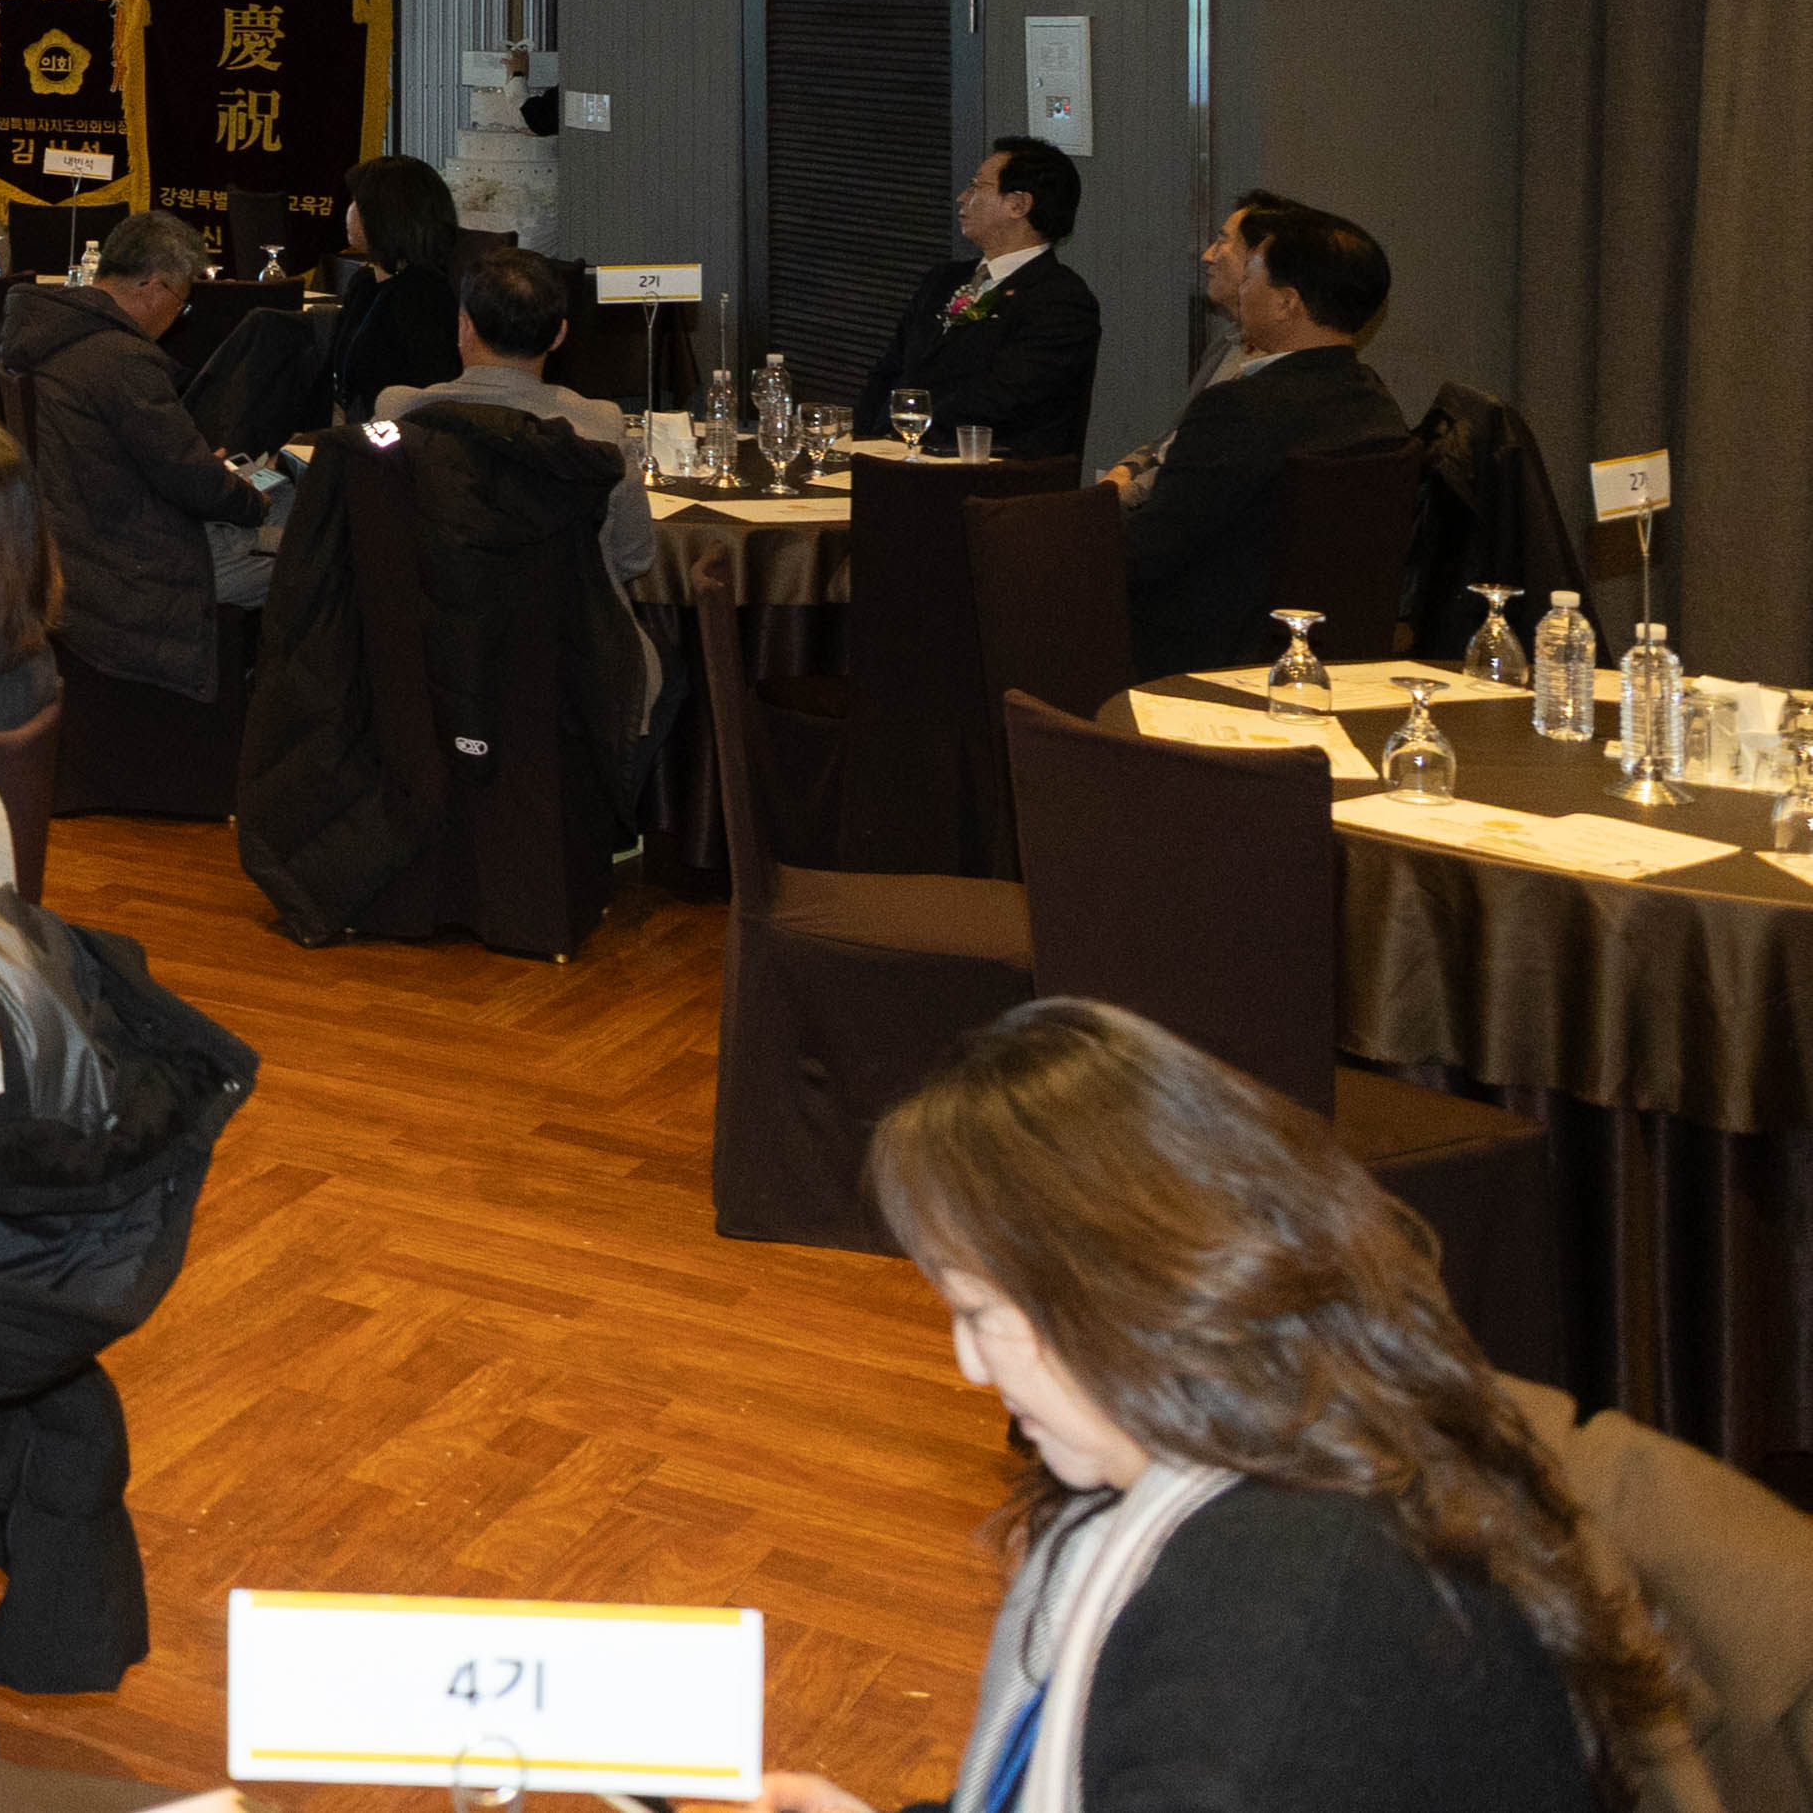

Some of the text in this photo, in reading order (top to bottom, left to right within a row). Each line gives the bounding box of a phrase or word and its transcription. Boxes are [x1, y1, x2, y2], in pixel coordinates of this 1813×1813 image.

[39, 55, 72, 72] 의회
[216, 2, 285, 153] 慶祝
[639, 275, 661, 288] 2기
[445, 1659, 546, 1711] 4기
